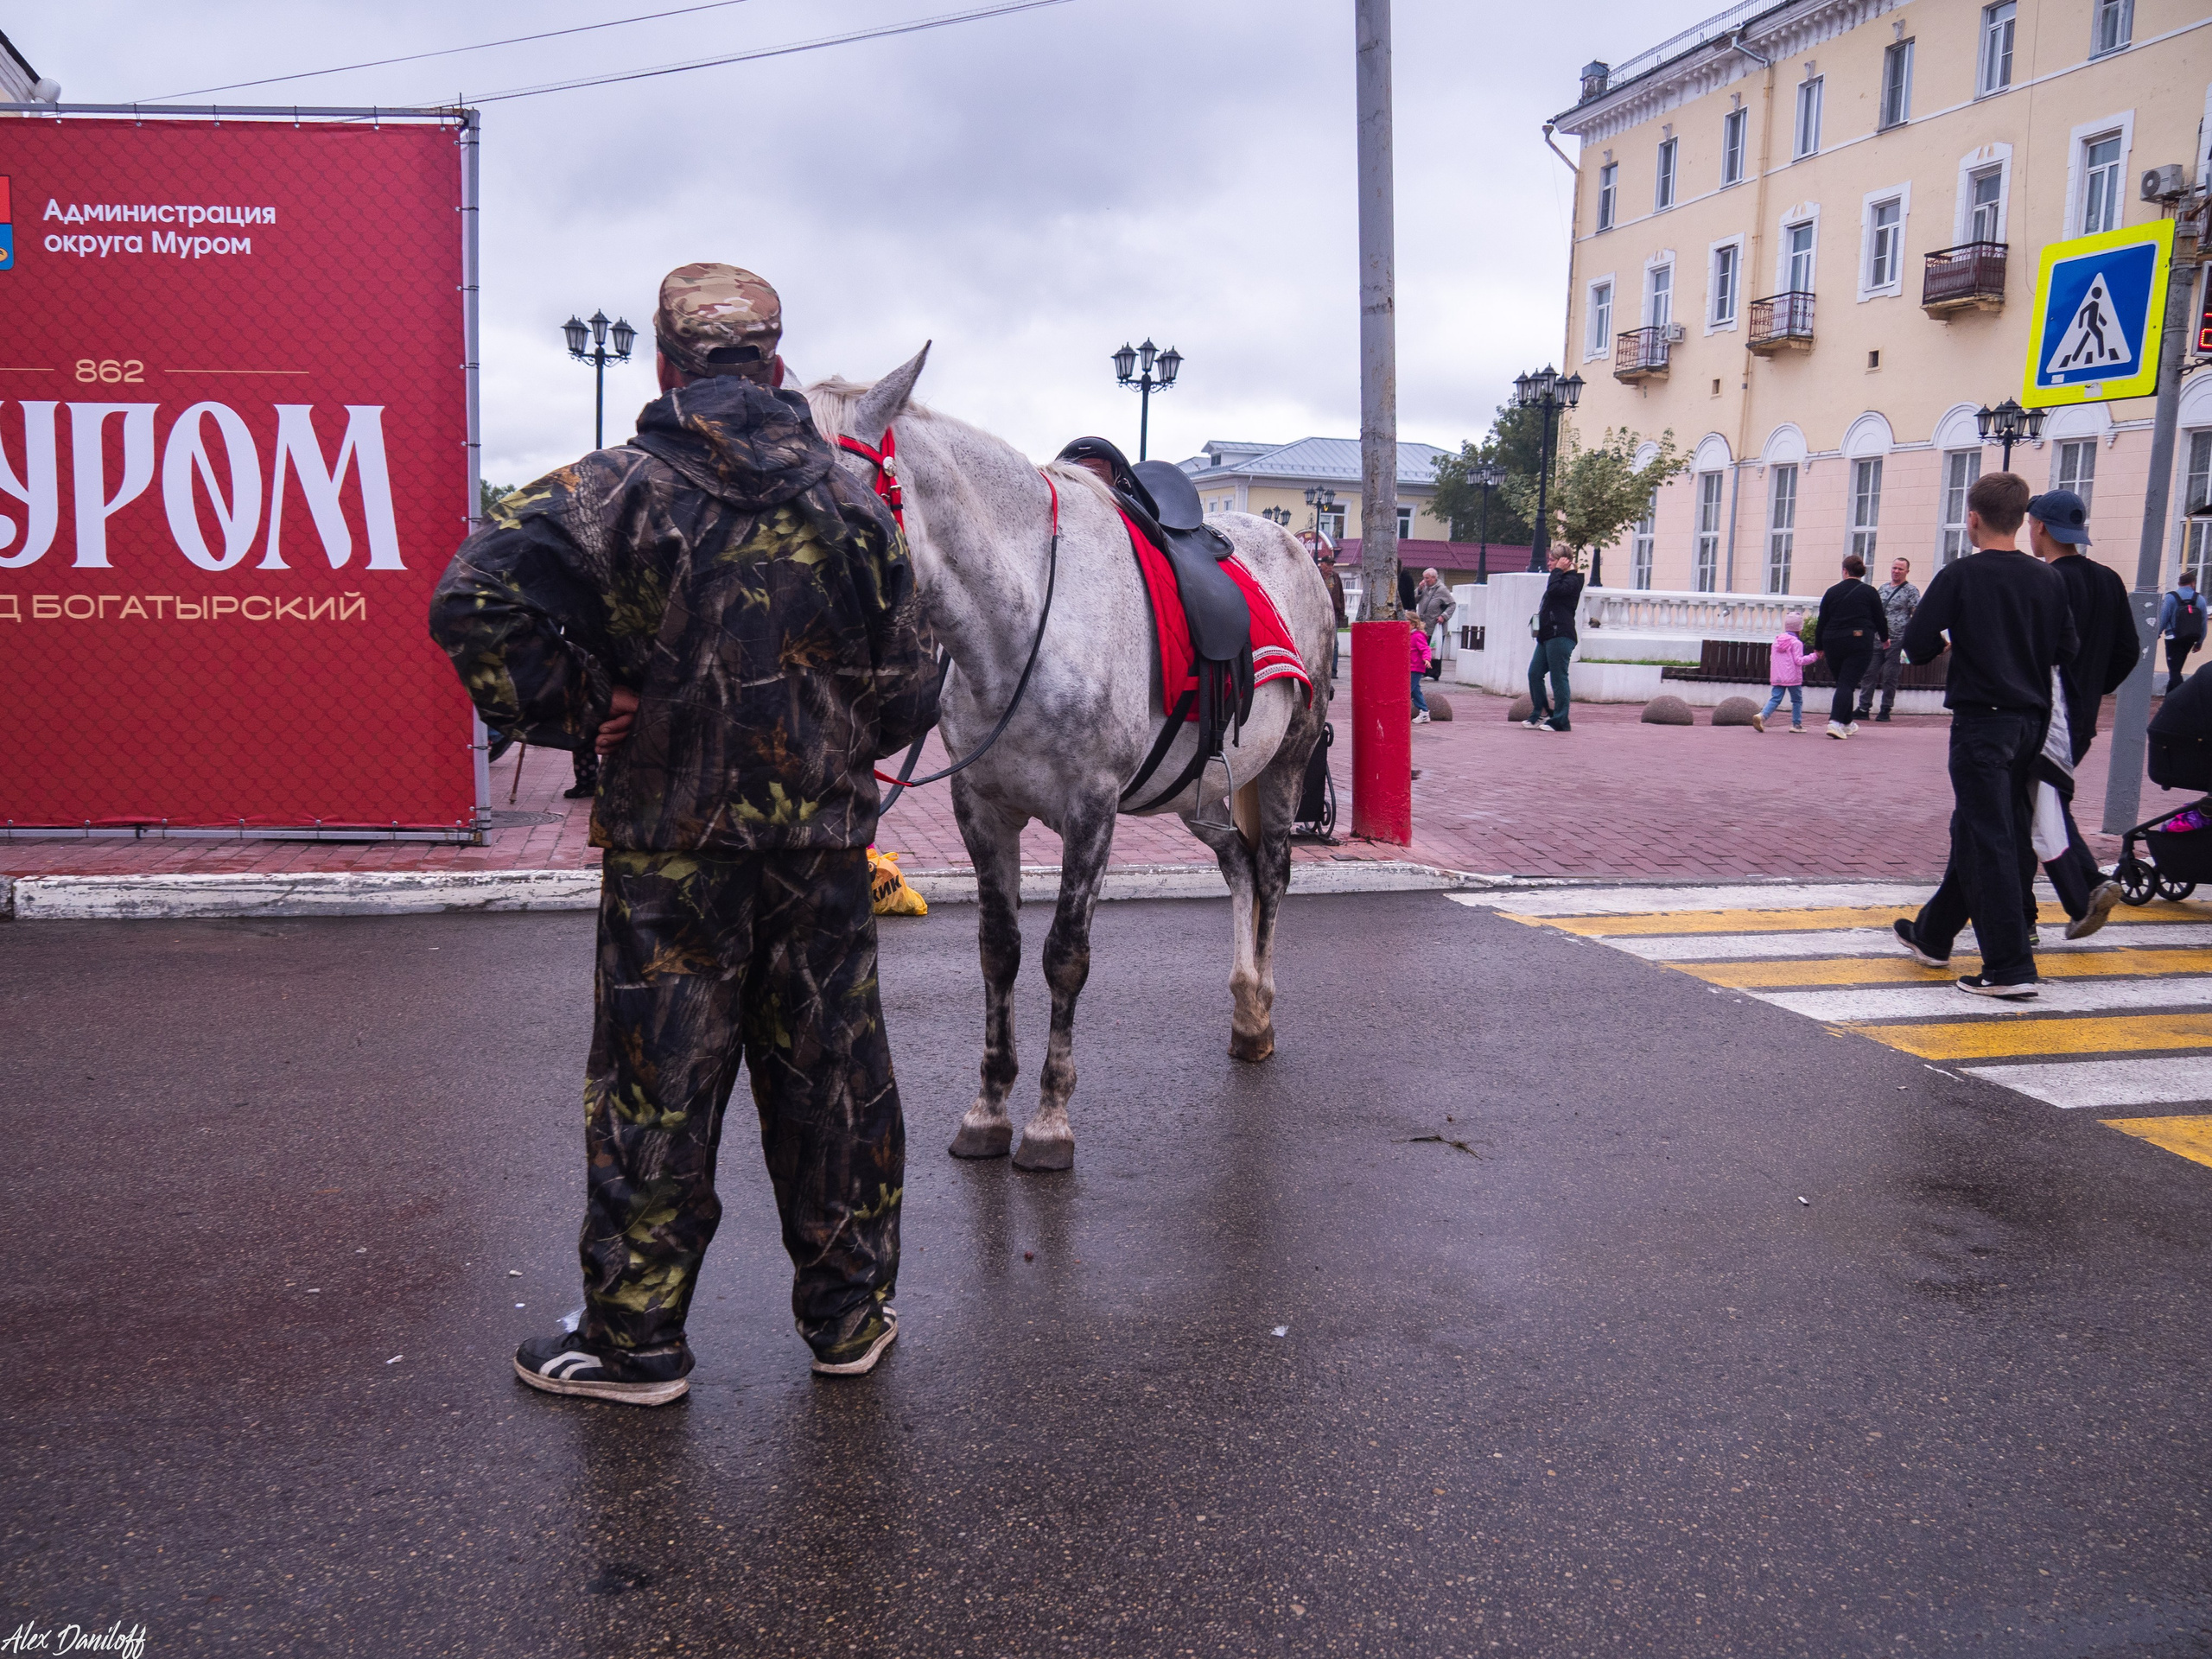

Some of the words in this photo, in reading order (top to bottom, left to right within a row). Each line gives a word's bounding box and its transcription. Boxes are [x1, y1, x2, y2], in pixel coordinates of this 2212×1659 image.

[43, 198, 276, 227] Администрация
[44, 234, 143, 258] округа
[151, 231, 251, 258] Муром
[75, 359, 144, 383] 862
[32, 592, 366, 621] БОГАТЫРСКИЙ
